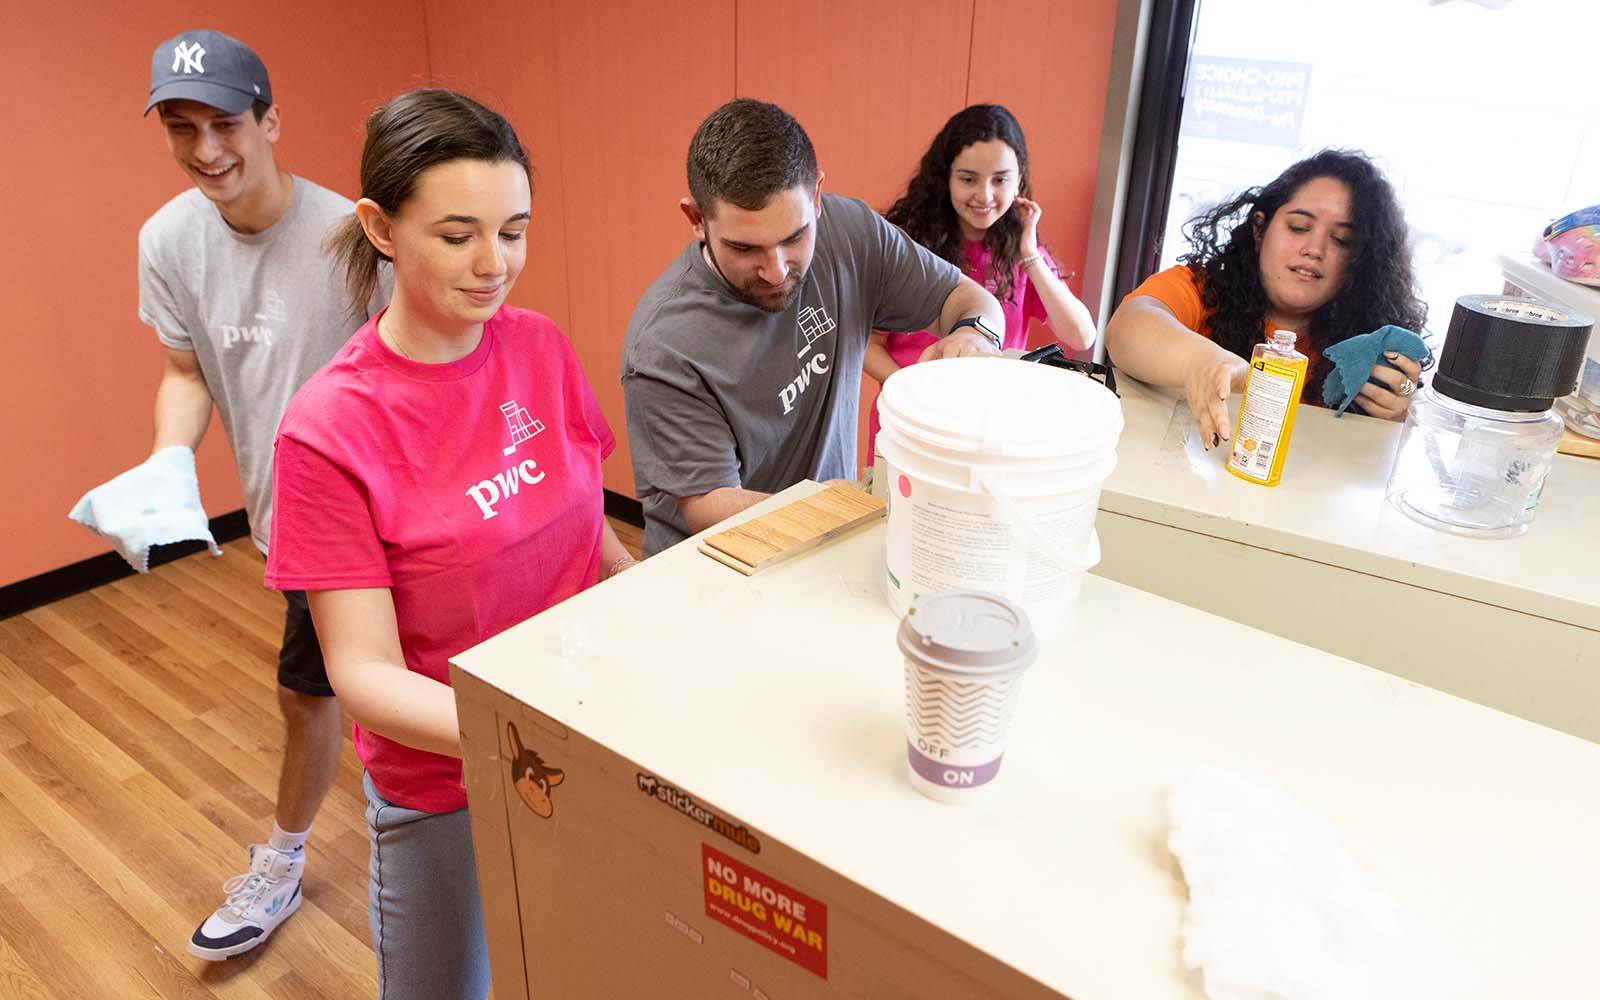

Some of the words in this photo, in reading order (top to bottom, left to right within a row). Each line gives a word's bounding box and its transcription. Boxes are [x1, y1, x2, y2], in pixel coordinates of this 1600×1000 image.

[172, 41, 206, 73] NY
[220, 324, 273, 348] pwc
[778, 353, 829, 415] pwc
[465, 459, 546, 520] pwc
[917, 738, 950, 758] OFF
[943, 769, 974, 784] ON
[707, 857, 738, 885] NO
[743, 876, 807, 922] MORE
[708, 878, 767, 921] DRUG
[772, 911, 823, 951] WAR
